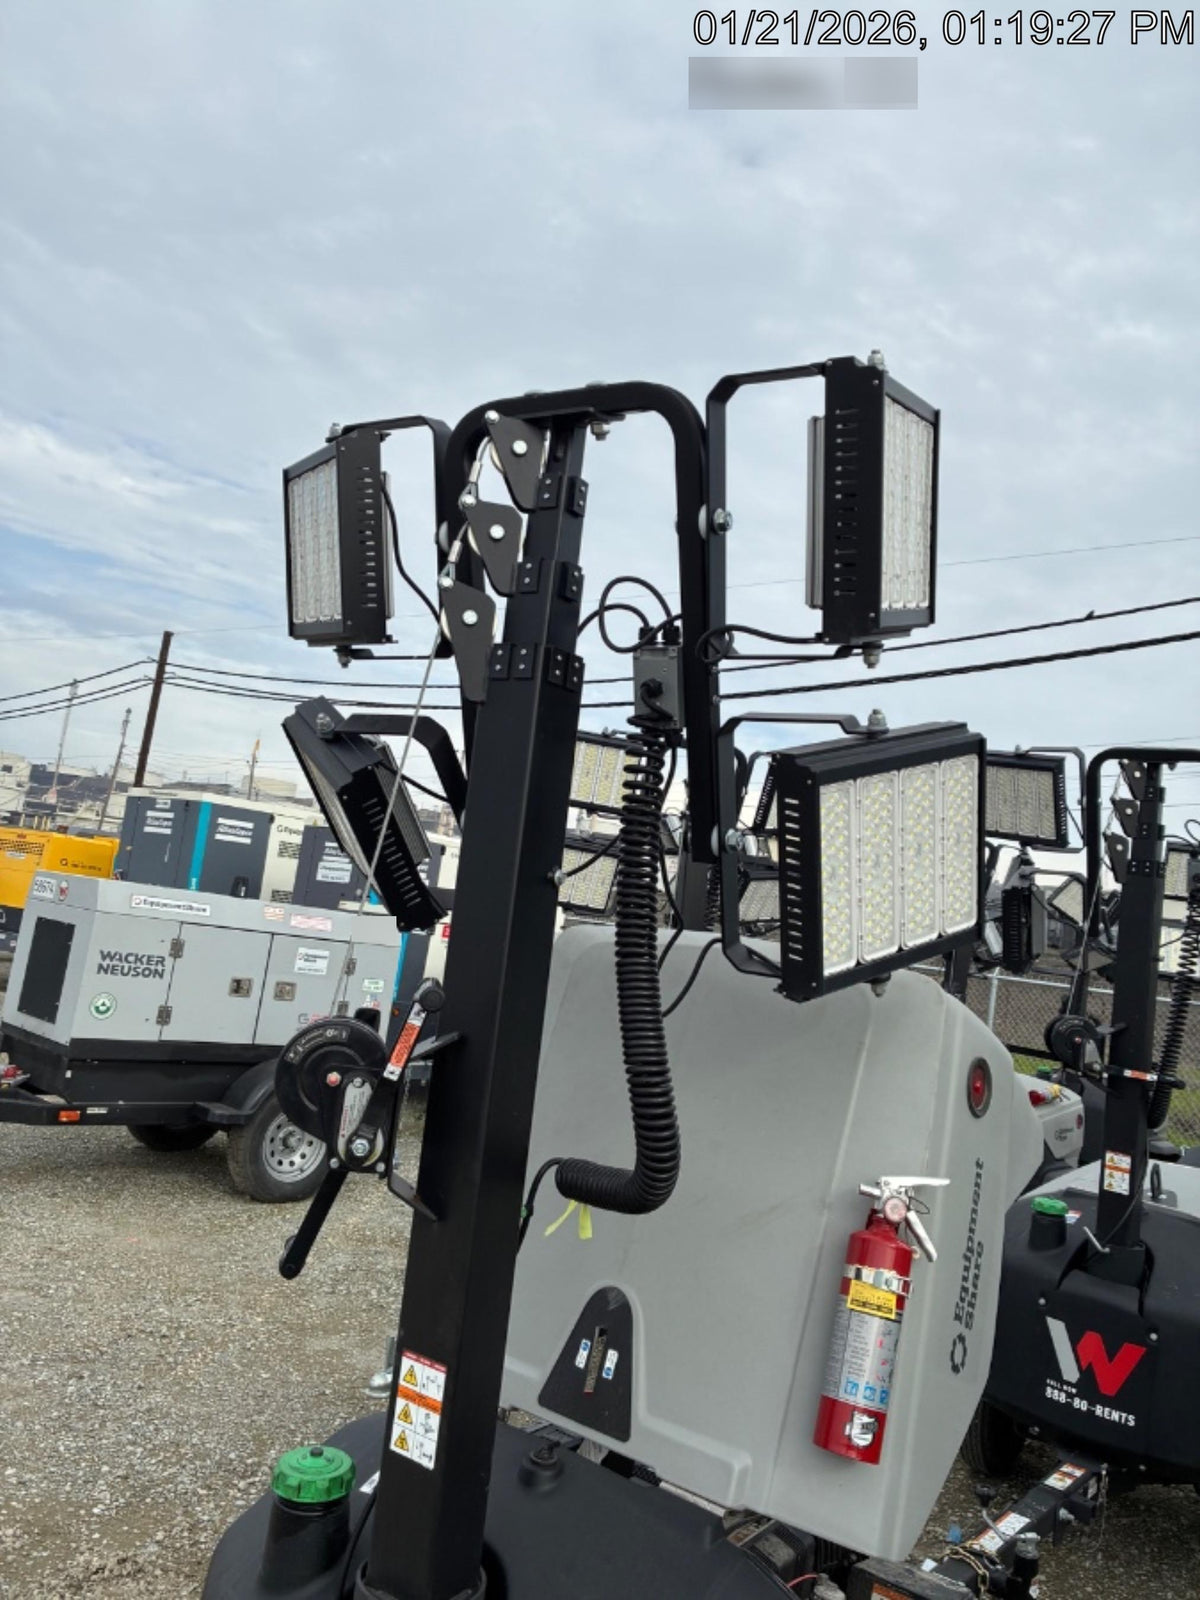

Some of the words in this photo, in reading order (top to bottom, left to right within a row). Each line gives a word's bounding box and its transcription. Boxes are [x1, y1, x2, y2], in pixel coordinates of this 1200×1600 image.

[96, 962, 165, 979] NEUSON
[99, 949, 166, 968] WACKER
[952, 1157, 984, 1326] Equipment
[964, 1240, 984, 1331] Share
